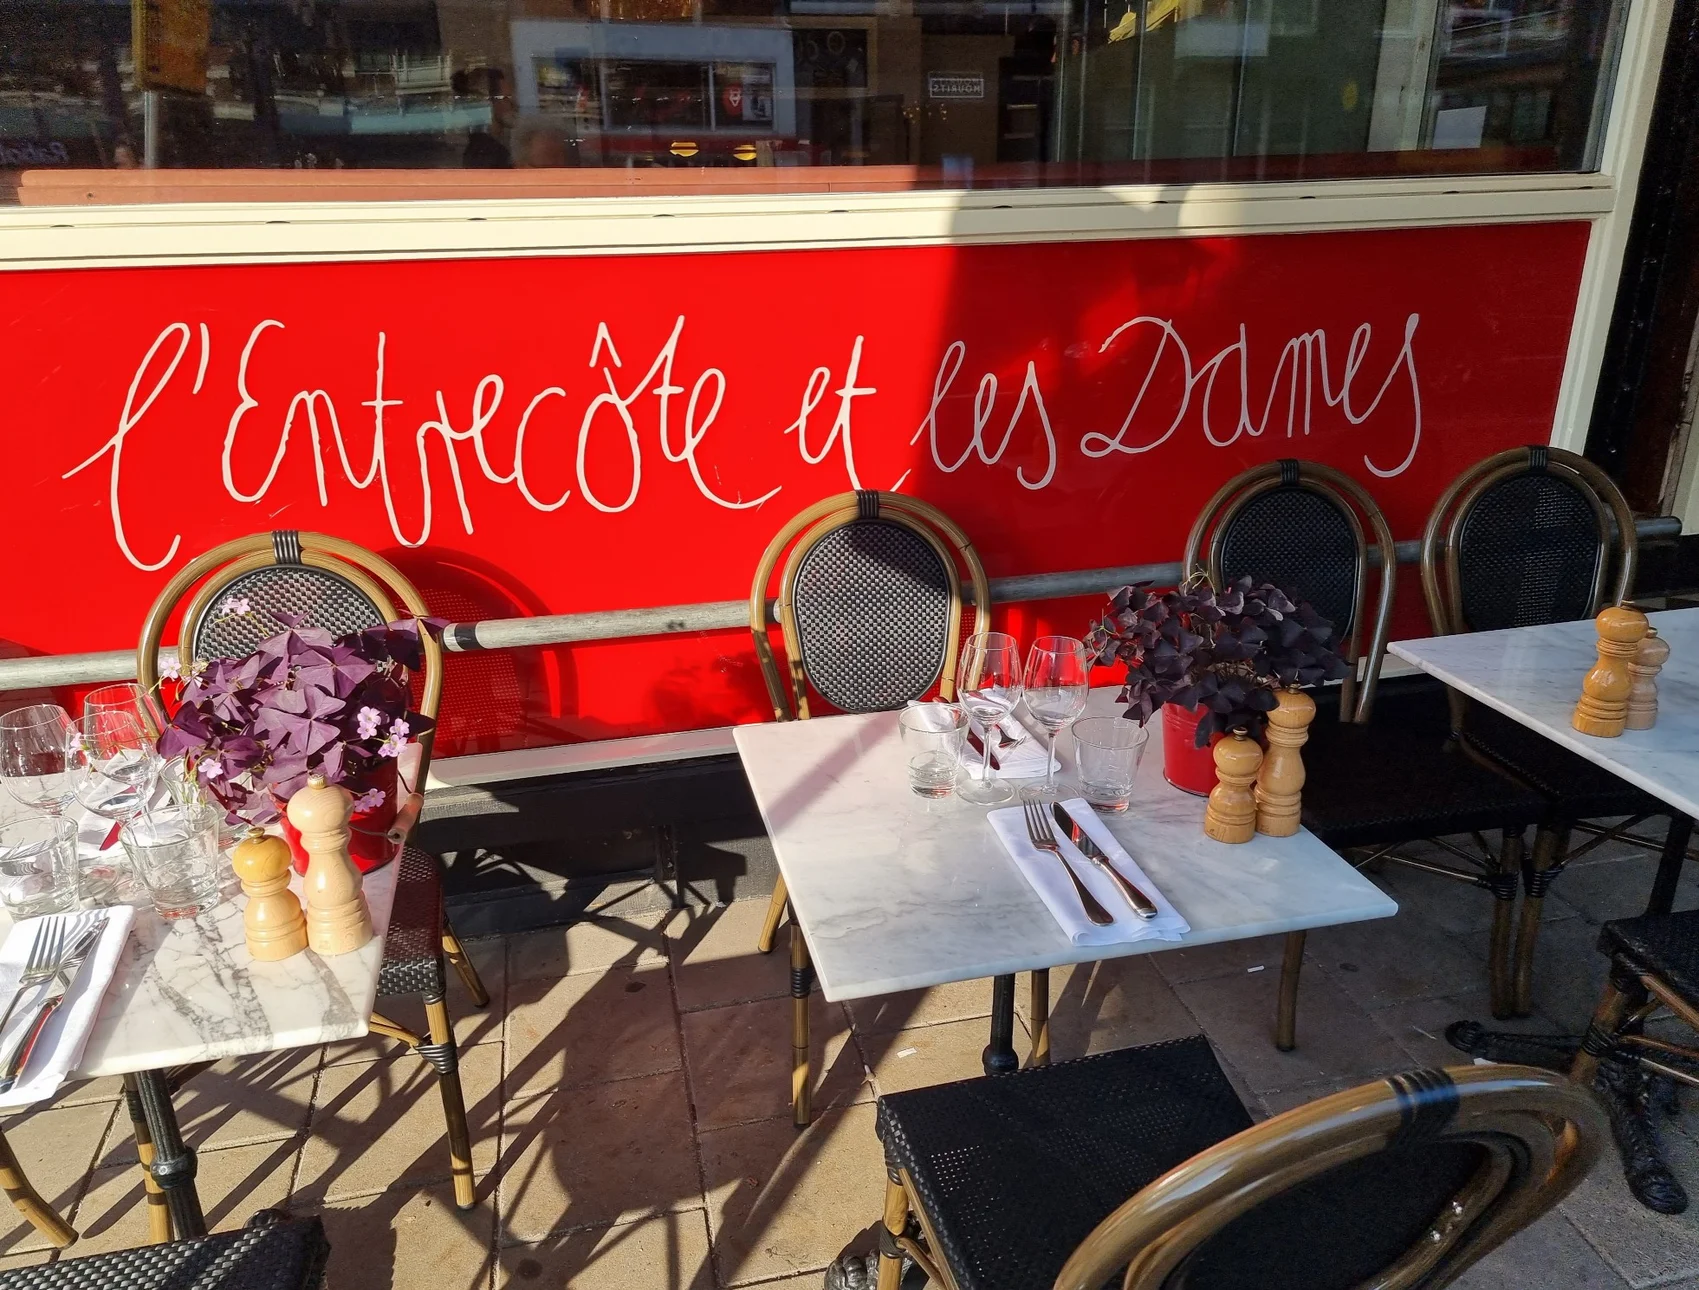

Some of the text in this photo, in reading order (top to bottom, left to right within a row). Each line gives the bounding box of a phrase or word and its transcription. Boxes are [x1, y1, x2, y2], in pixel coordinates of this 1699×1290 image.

[62, 313, 1421, 571] l'Entrecôte et les Dames
